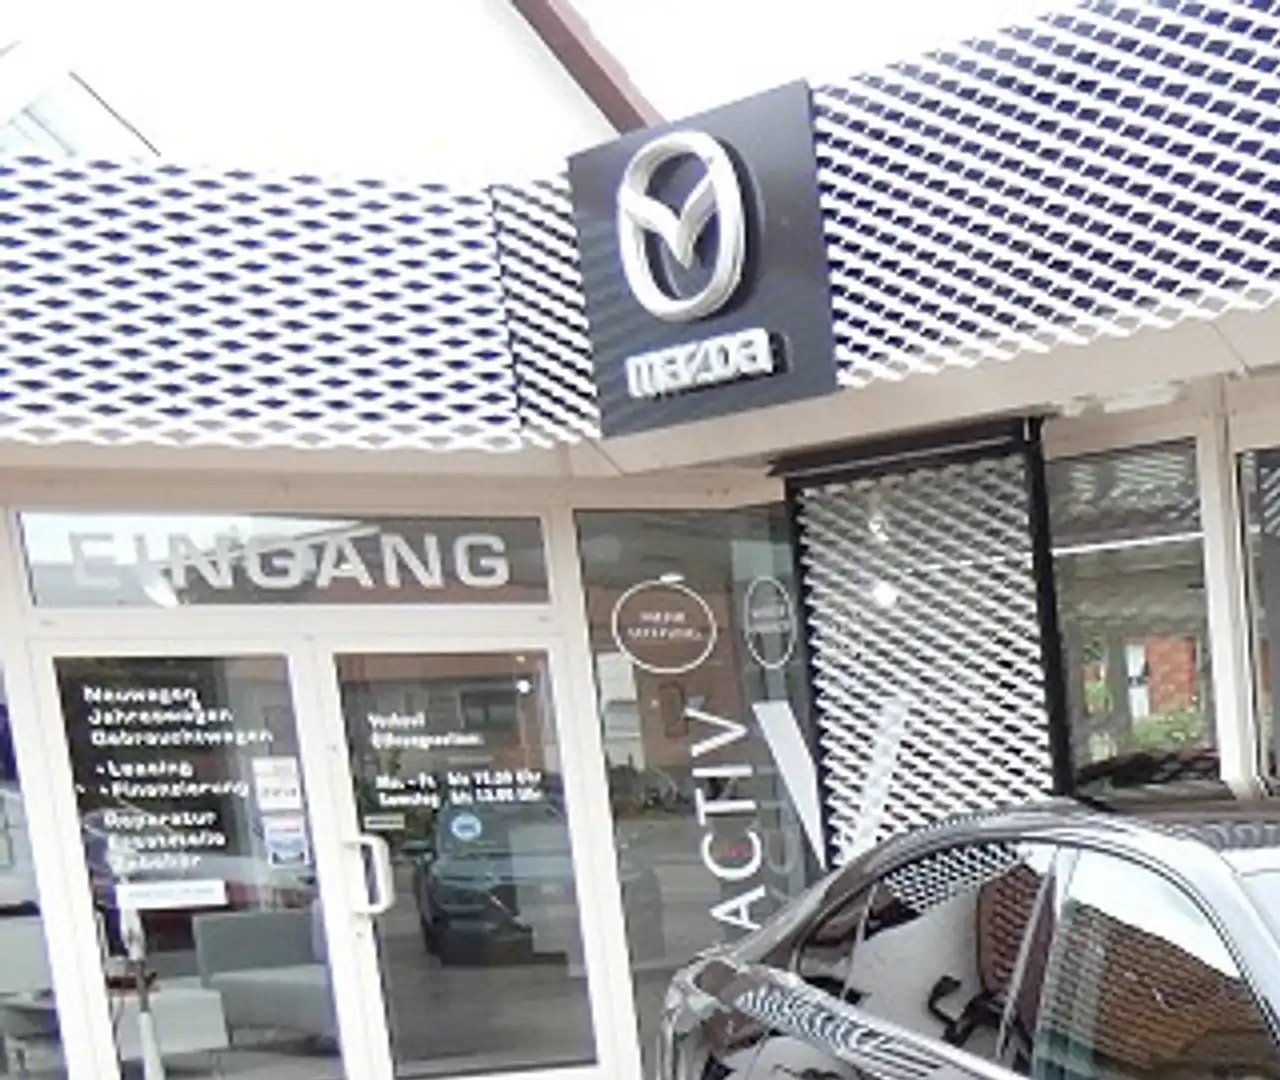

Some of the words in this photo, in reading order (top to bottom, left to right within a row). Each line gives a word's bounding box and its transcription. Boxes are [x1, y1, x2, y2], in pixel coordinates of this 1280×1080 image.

[625, 328, 774, 398] mazda
[69, 530, 511, 590] EINGANG
[83, 686, 199, 704] Neuwagen
[684, 707, 766, 931] ACTIV
